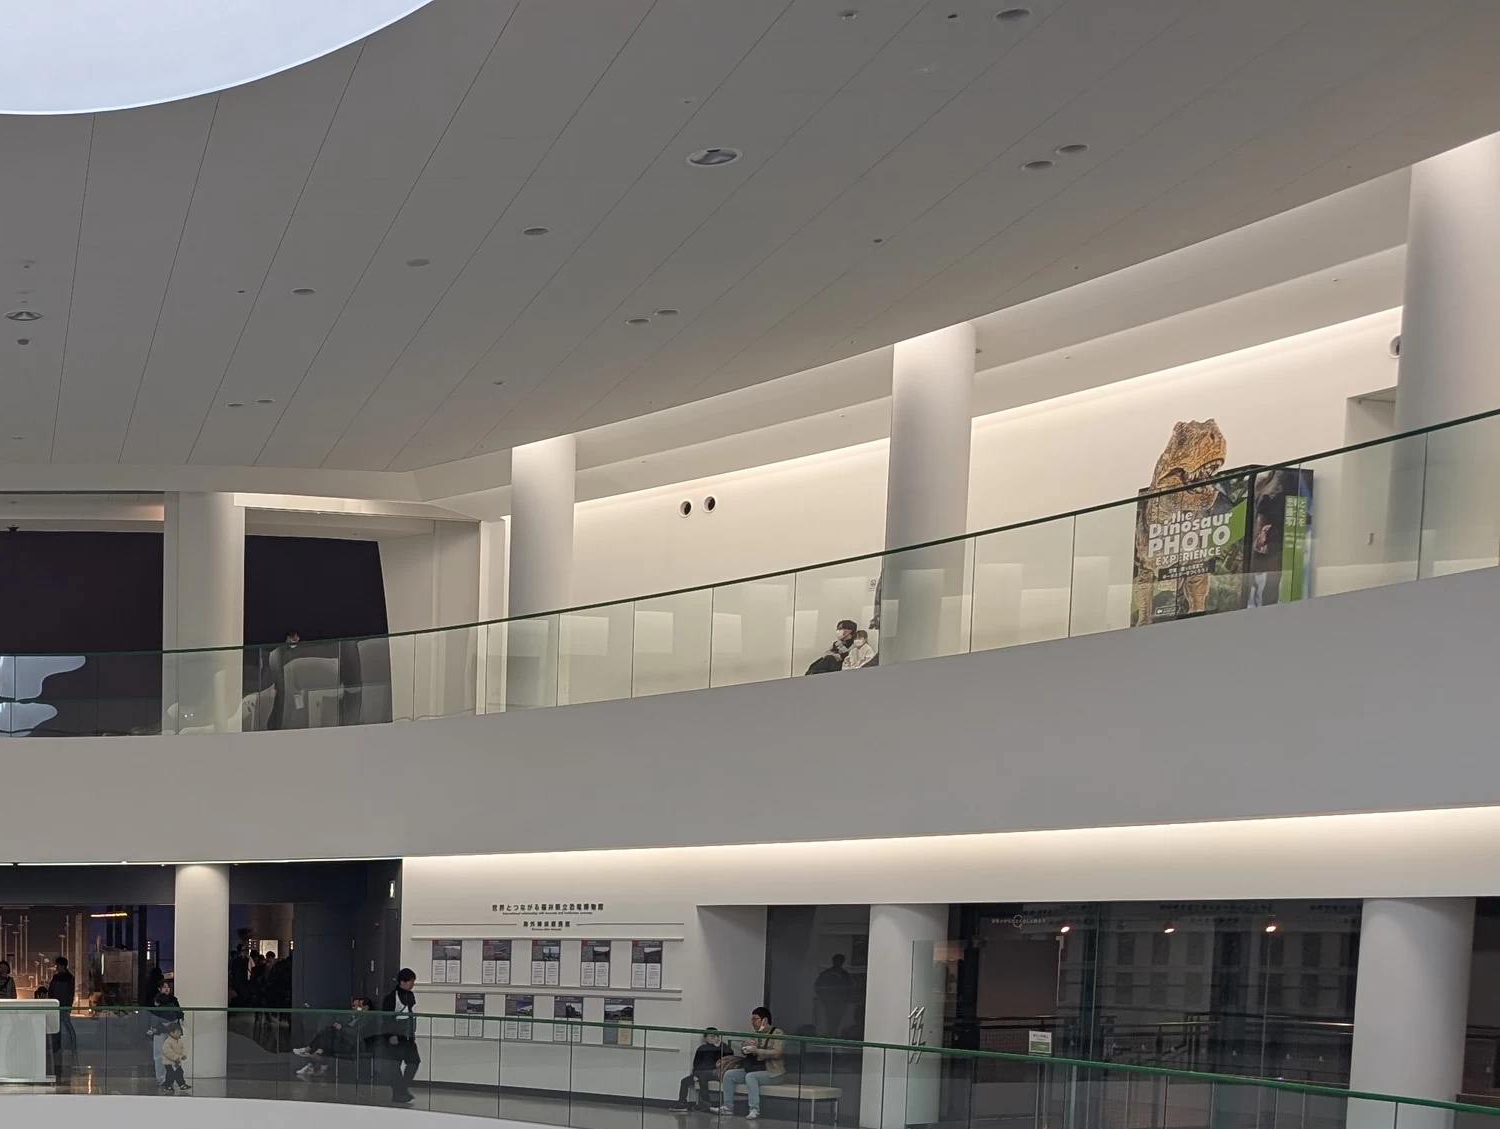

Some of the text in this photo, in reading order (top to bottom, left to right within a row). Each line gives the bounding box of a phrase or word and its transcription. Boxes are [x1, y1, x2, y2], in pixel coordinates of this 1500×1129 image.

[1149, 512, 1232, 539] Dinosaur
[1171, 511, 1193, 523] the
[1148, 525, 1231, 558] PHOTO
[1155, 547, 1221, 566] EXPERIENCE
